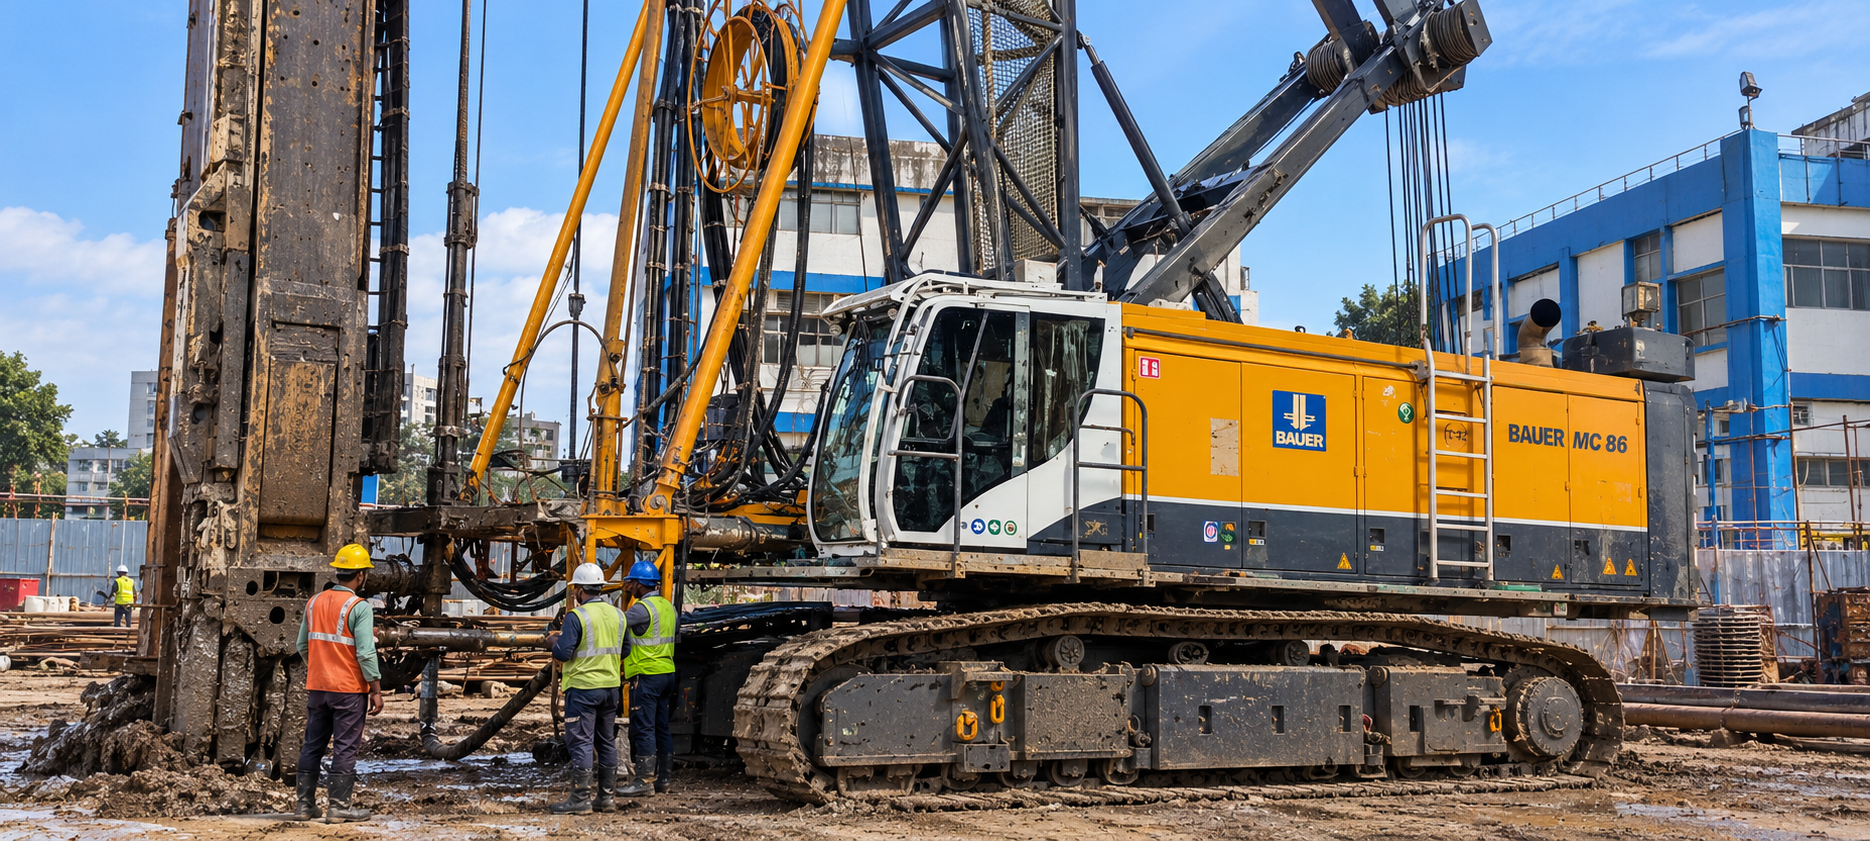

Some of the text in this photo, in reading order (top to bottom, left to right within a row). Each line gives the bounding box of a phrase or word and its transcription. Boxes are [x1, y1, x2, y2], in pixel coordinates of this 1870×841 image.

[1275, 431, 1324, 448] BAUER
[1508, 424, 1629, 454] BAUER MC 86
